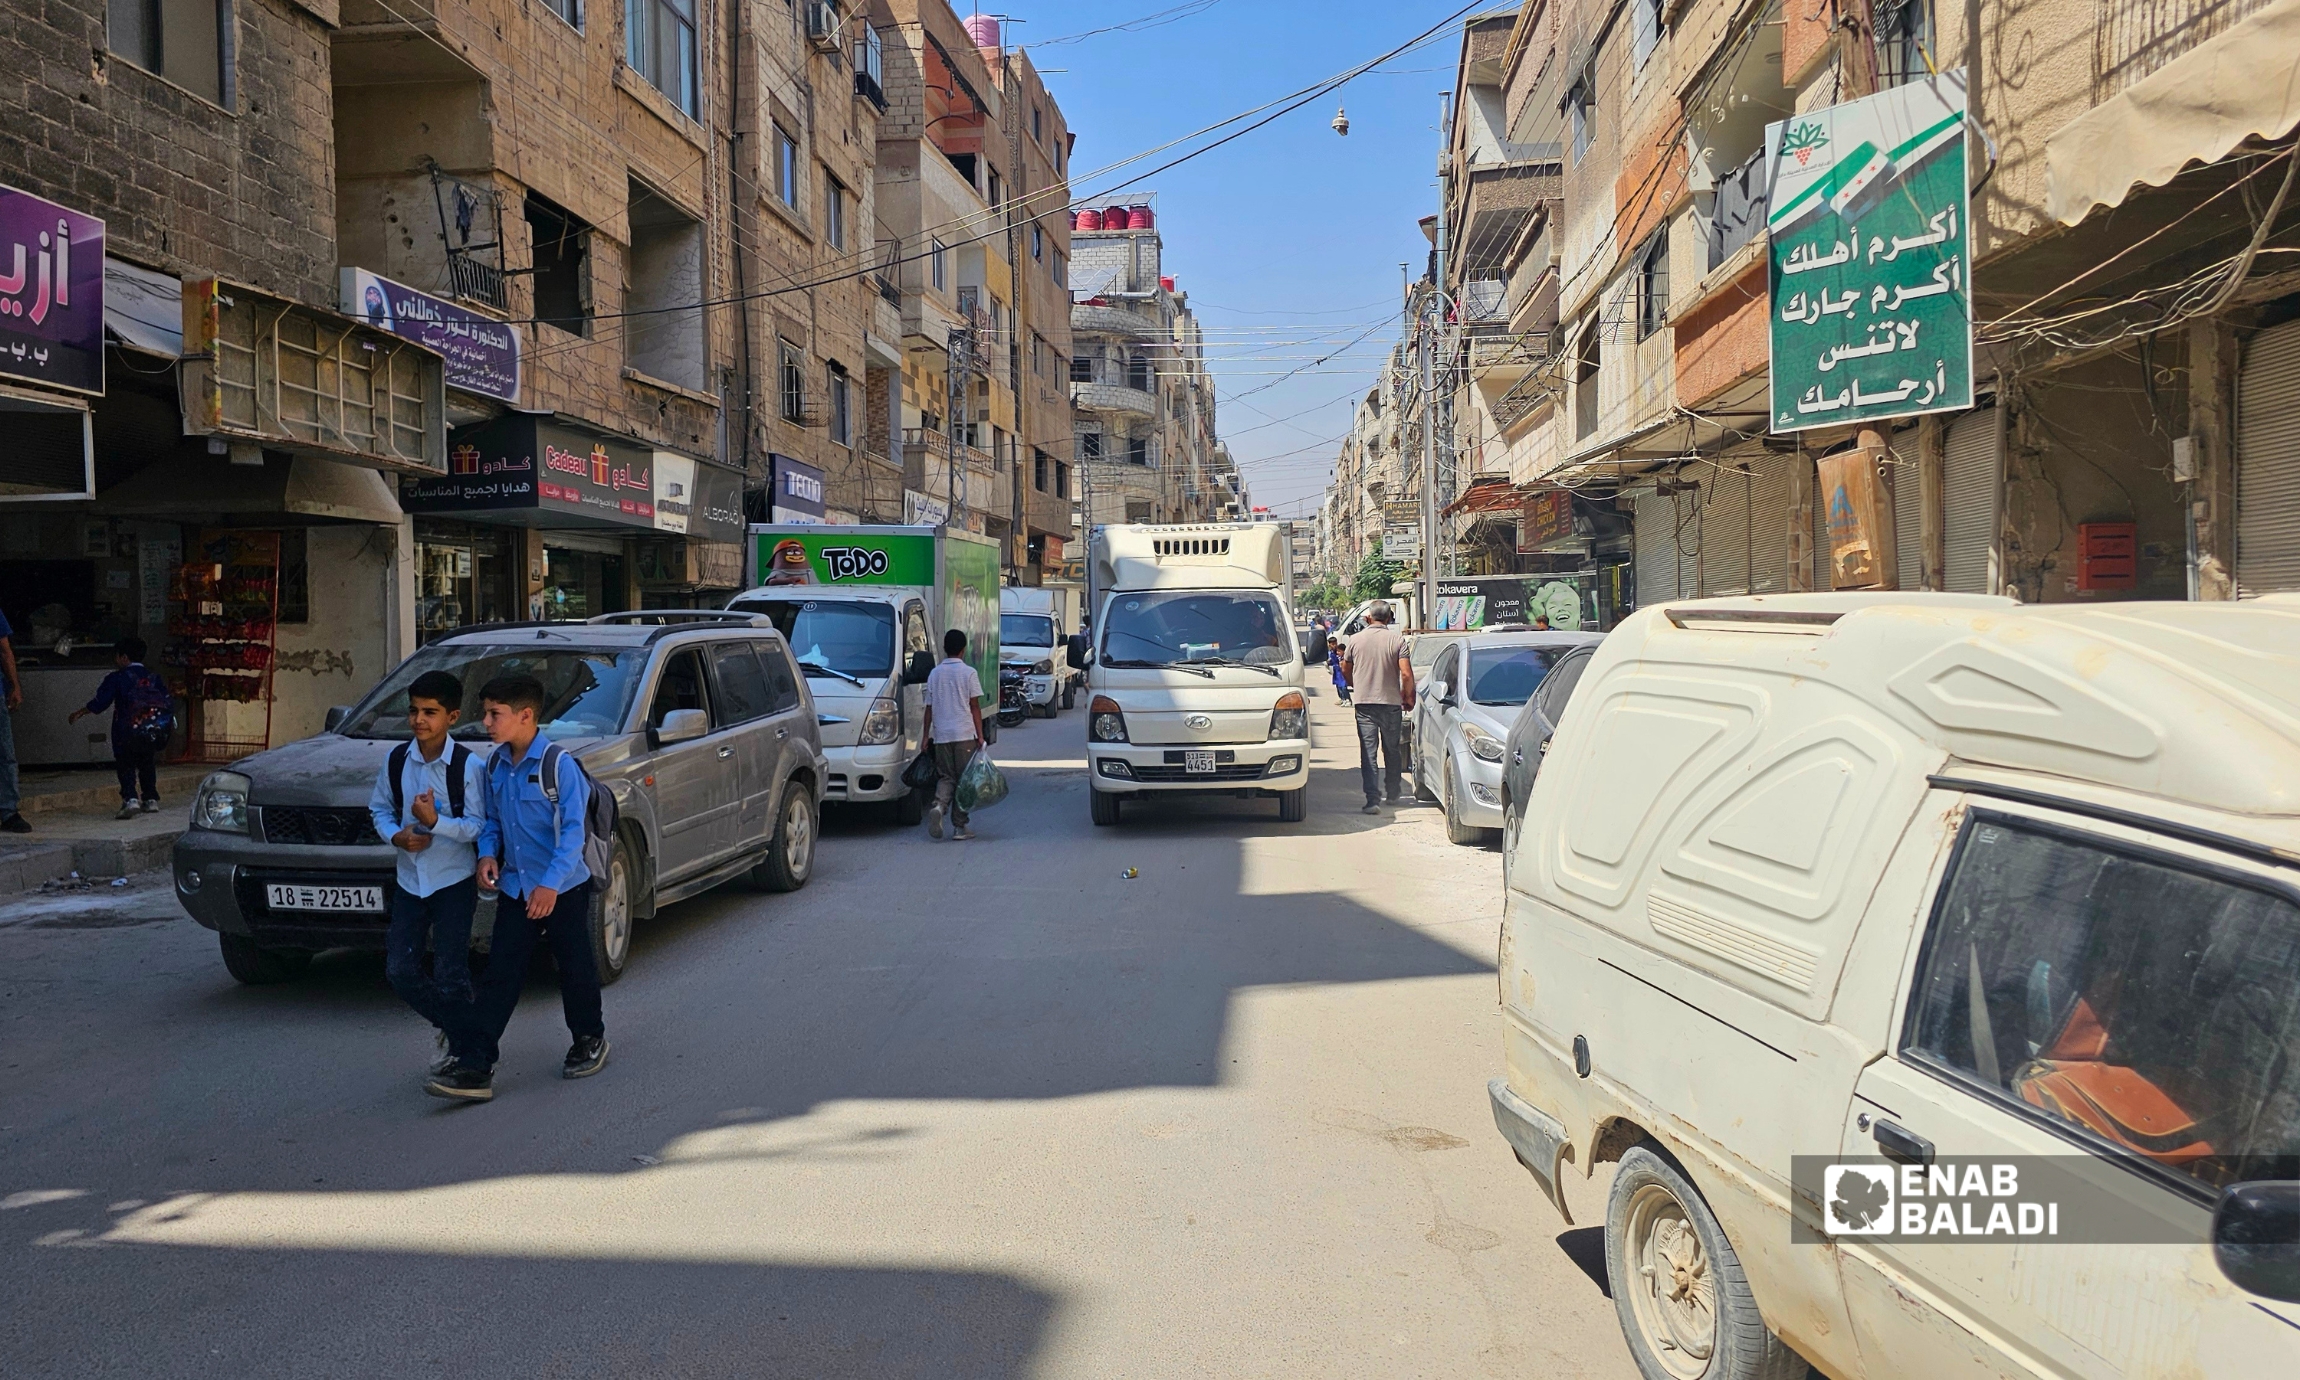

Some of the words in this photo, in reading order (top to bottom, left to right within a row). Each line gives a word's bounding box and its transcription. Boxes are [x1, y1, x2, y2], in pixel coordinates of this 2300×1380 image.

[1868, 203, 1957, 265] أكرم
[1782, 226, 1859, 275] أهلك
[0, 218, 68, 326] أزي
[1870, 254, 1961, 314] أكرم
[1781, 287, 1861, 325] جارك
[444, 316, 470, 338] نور
[472, 322, 508, 350] الدكتورة
[1797, 359, 1946, 414] أرحامك
[482, 456, 531, 475] كادو
[545, 445, 588, 477] Cadeau
[612, 463, 649, 491] كادو
[408, 485, 460, 501] المناسبات
[464, 484, 498, 499] لجميع
[502, 482, 531, 497] هدايا
[702, 506, 739, 525] ALBORAQ
[1437, 583, 1478, 594] okavera
[1496, 609, 1519, 619] أسنان
[1187, 760, 1214, 771] 4451
[274, 887, 296, 906] 18
[318, 888, 376, 908] 22514
